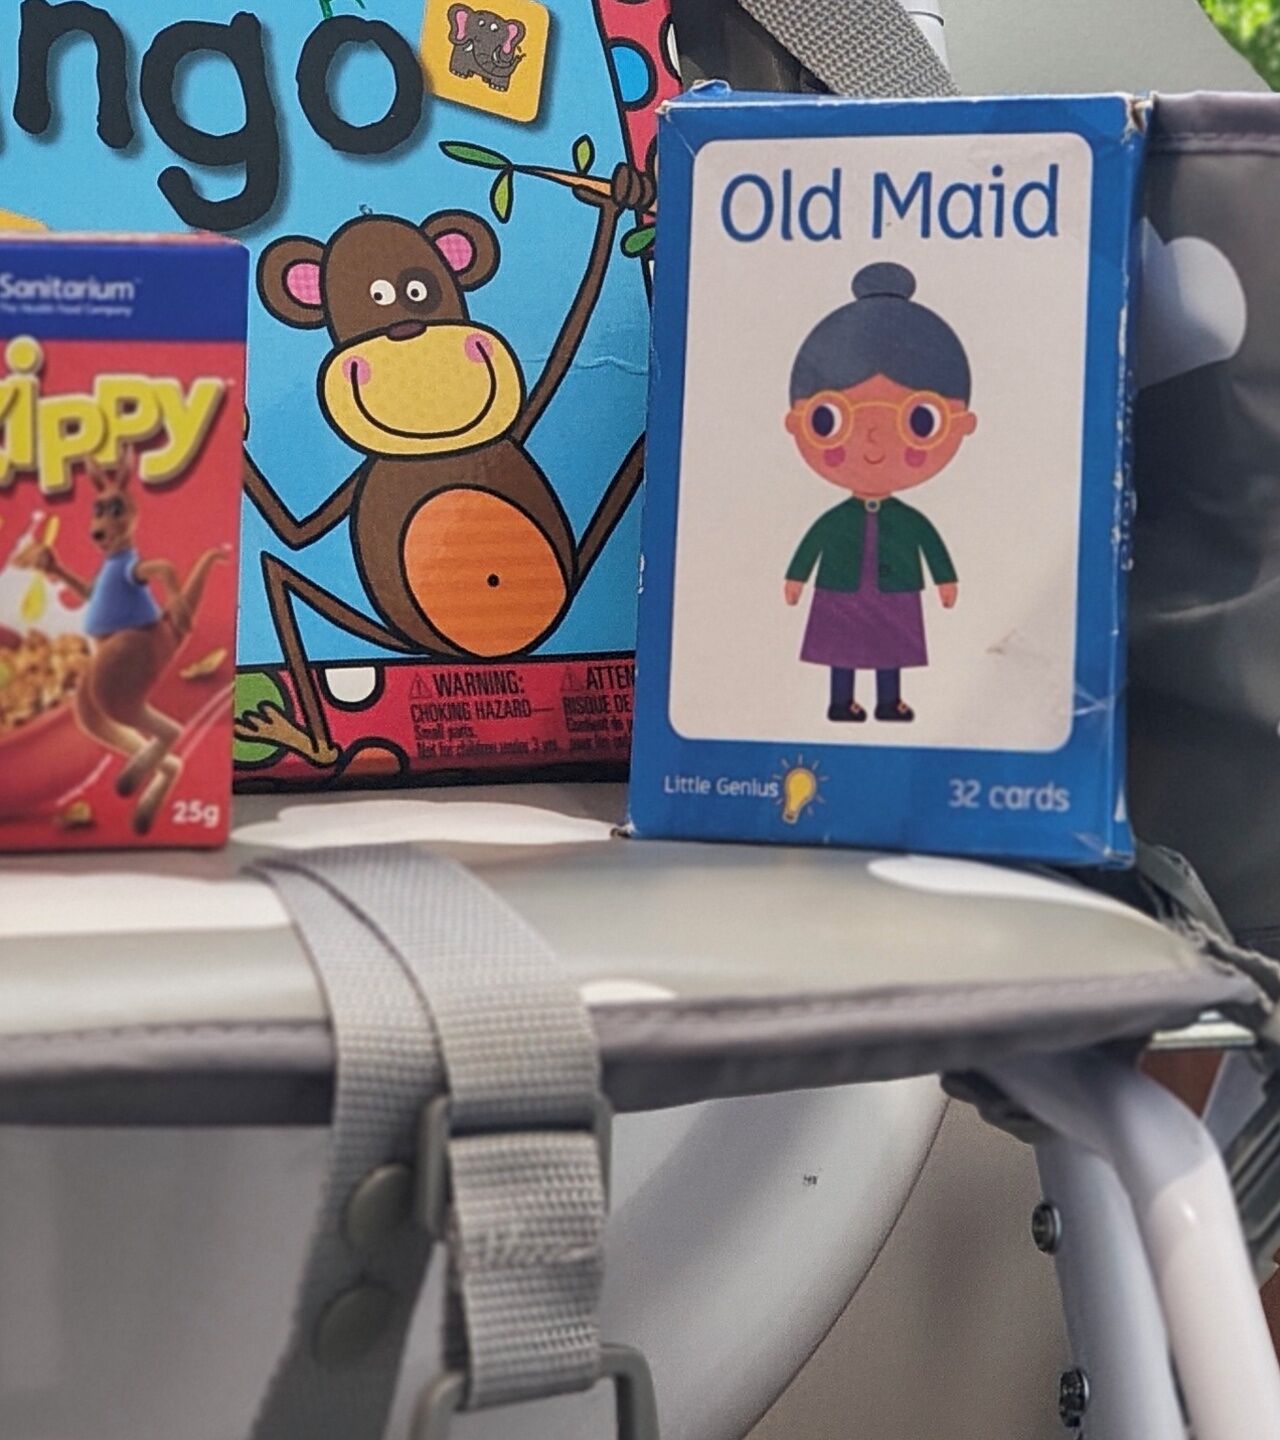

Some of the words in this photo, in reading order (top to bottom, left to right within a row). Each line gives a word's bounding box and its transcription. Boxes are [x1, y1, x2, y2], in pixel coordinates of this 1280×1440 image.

[721, 168, 843, 244] Old
[872, 163, 1058, 239] Maid
[433, 670, 524, 697] WARNING:
[410, 701, 470, 723] CHOKING
[664, 775, 711, 796] Little
[717, 777, 778, 798] Genius
[949, 779, 980, 809] 32
[989, 780, 1070, 812] cards
[173, 801, 219, 827] 25g
